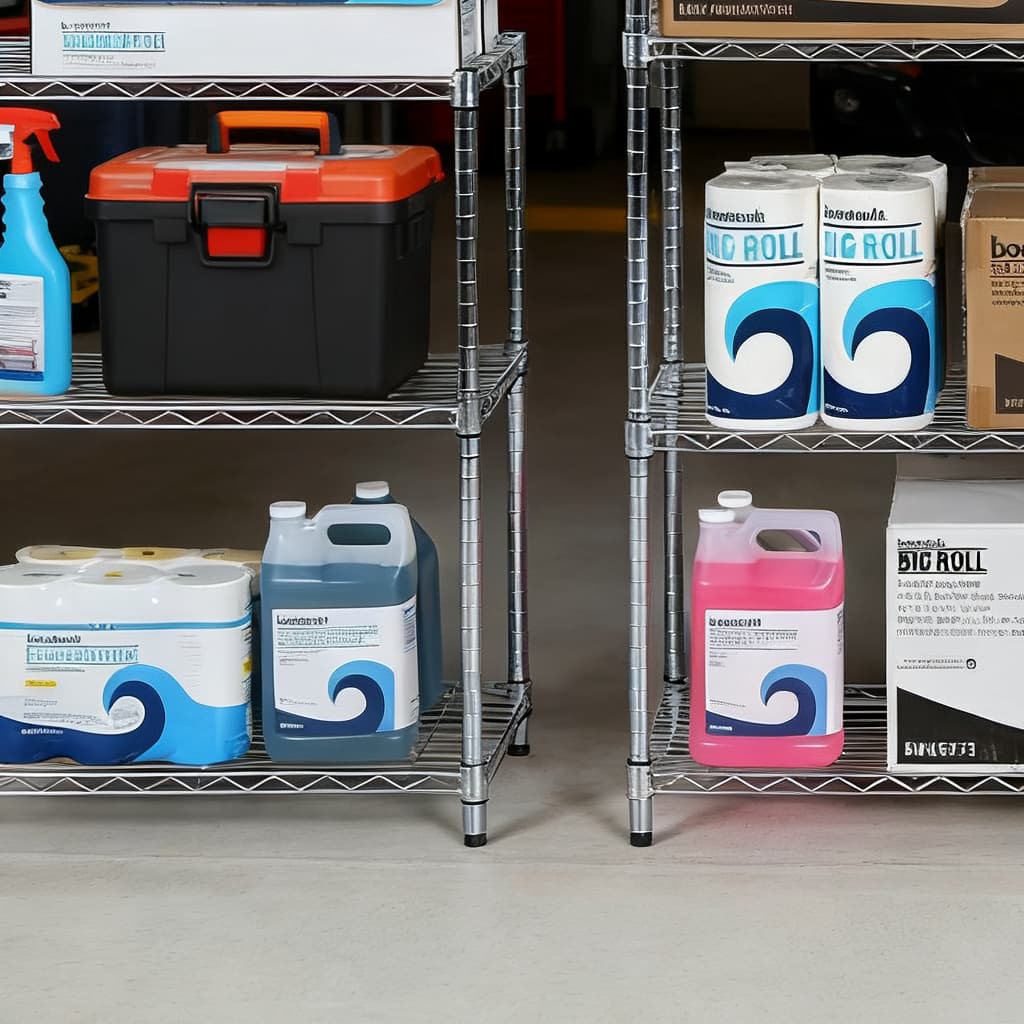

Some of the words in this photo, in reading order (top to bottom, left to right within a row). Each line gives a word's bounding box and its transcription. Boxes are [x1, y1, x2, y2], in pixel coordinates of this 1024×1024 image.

[743, 231, 804, 261] ROLL
[862, 229, 925, 259] ROLL
[936, 550, 988, 572] ROLL
